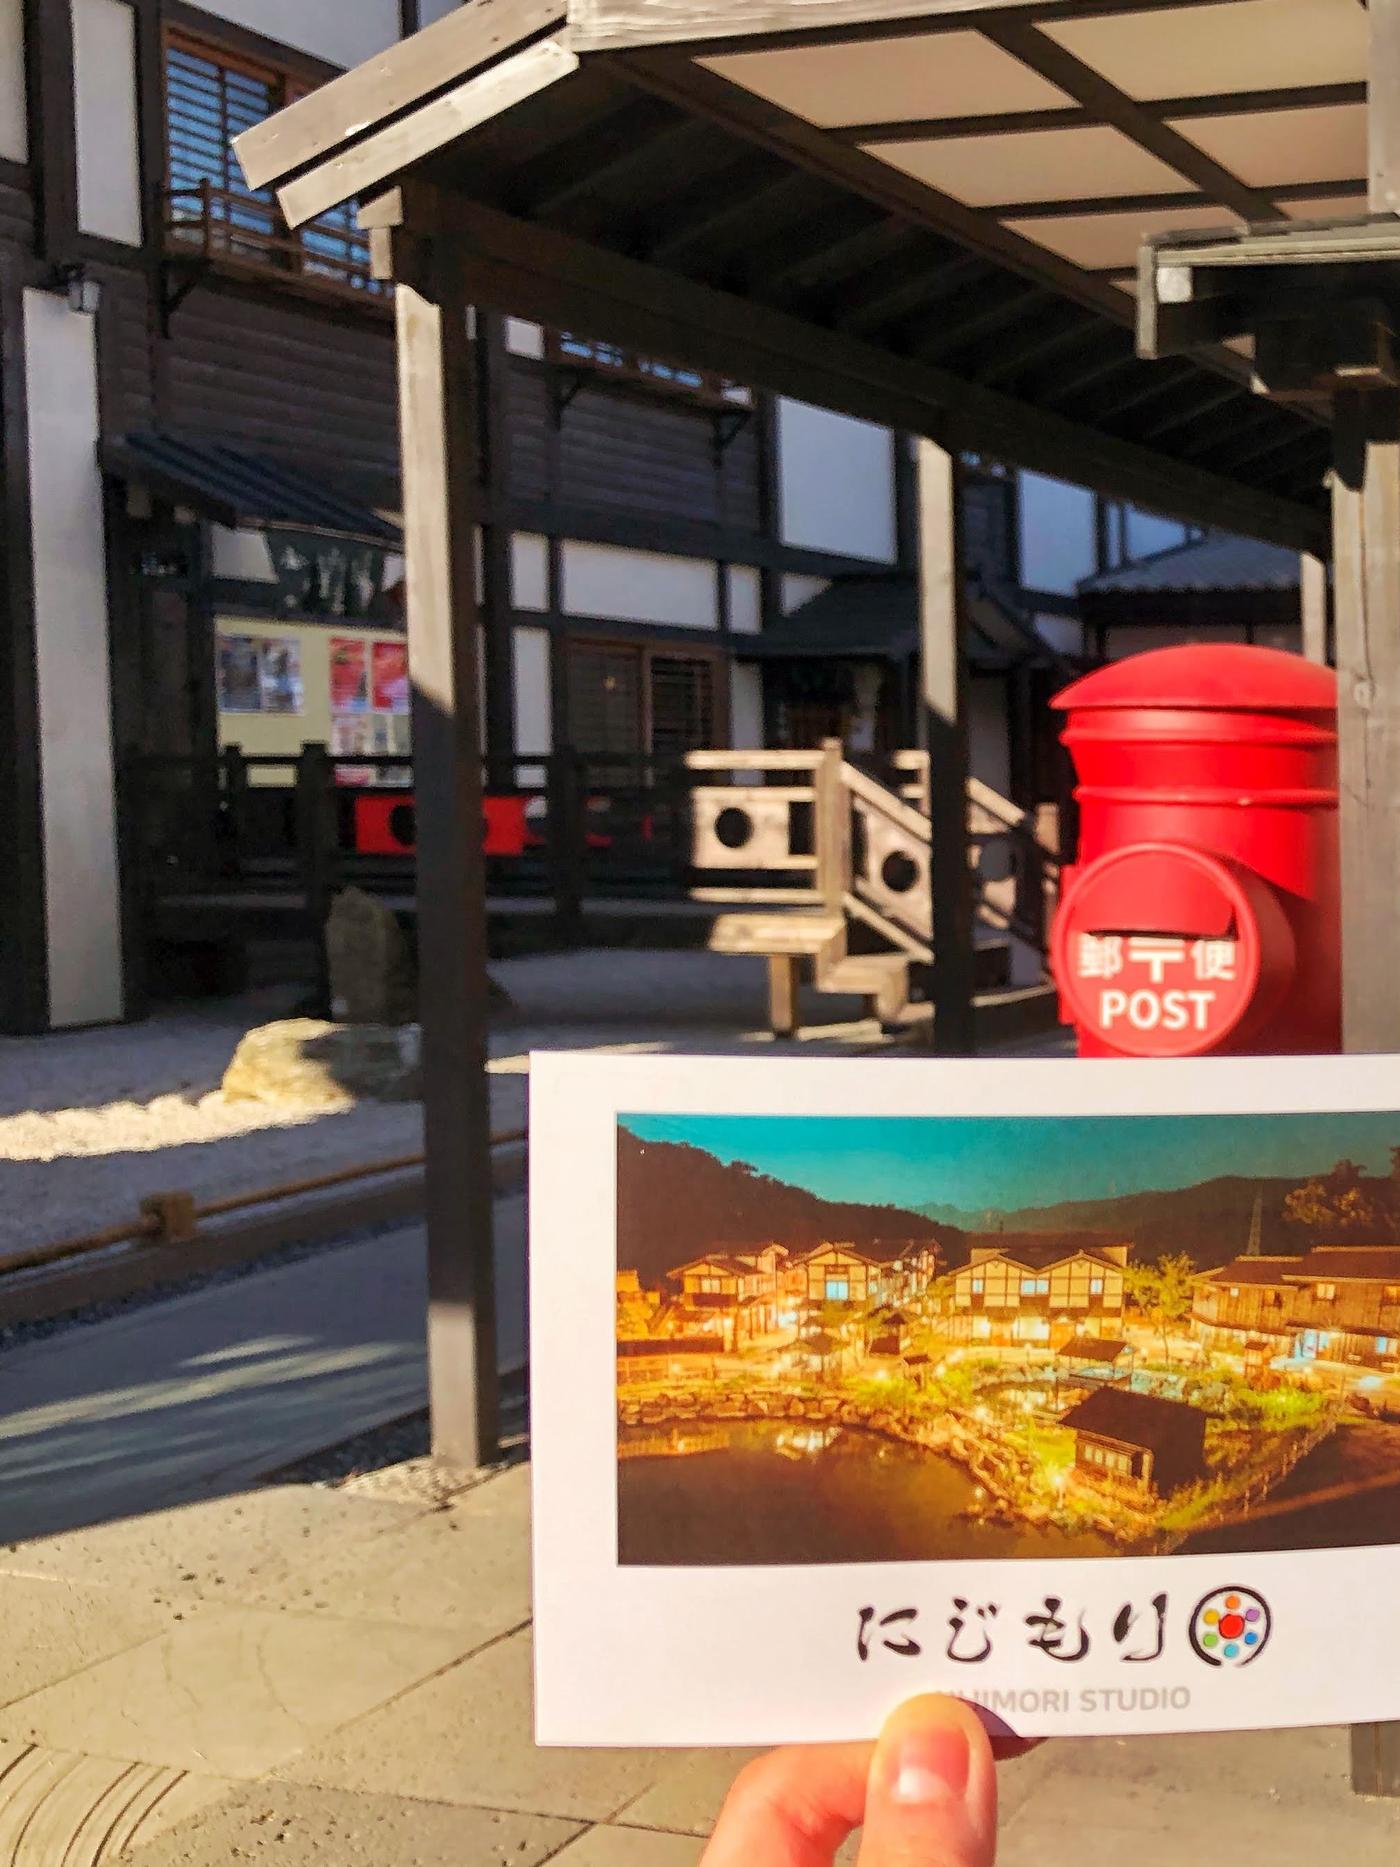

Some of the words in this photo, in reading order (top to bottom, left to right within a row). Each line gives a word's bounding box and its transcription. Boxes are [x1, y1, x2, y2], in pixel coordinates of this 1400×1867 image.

[1101, 989, 1216, 1030] POST
[857, 1593, 1168, 1663] にじもり
[1079, 1685, 1191, 1713] STUDIO
